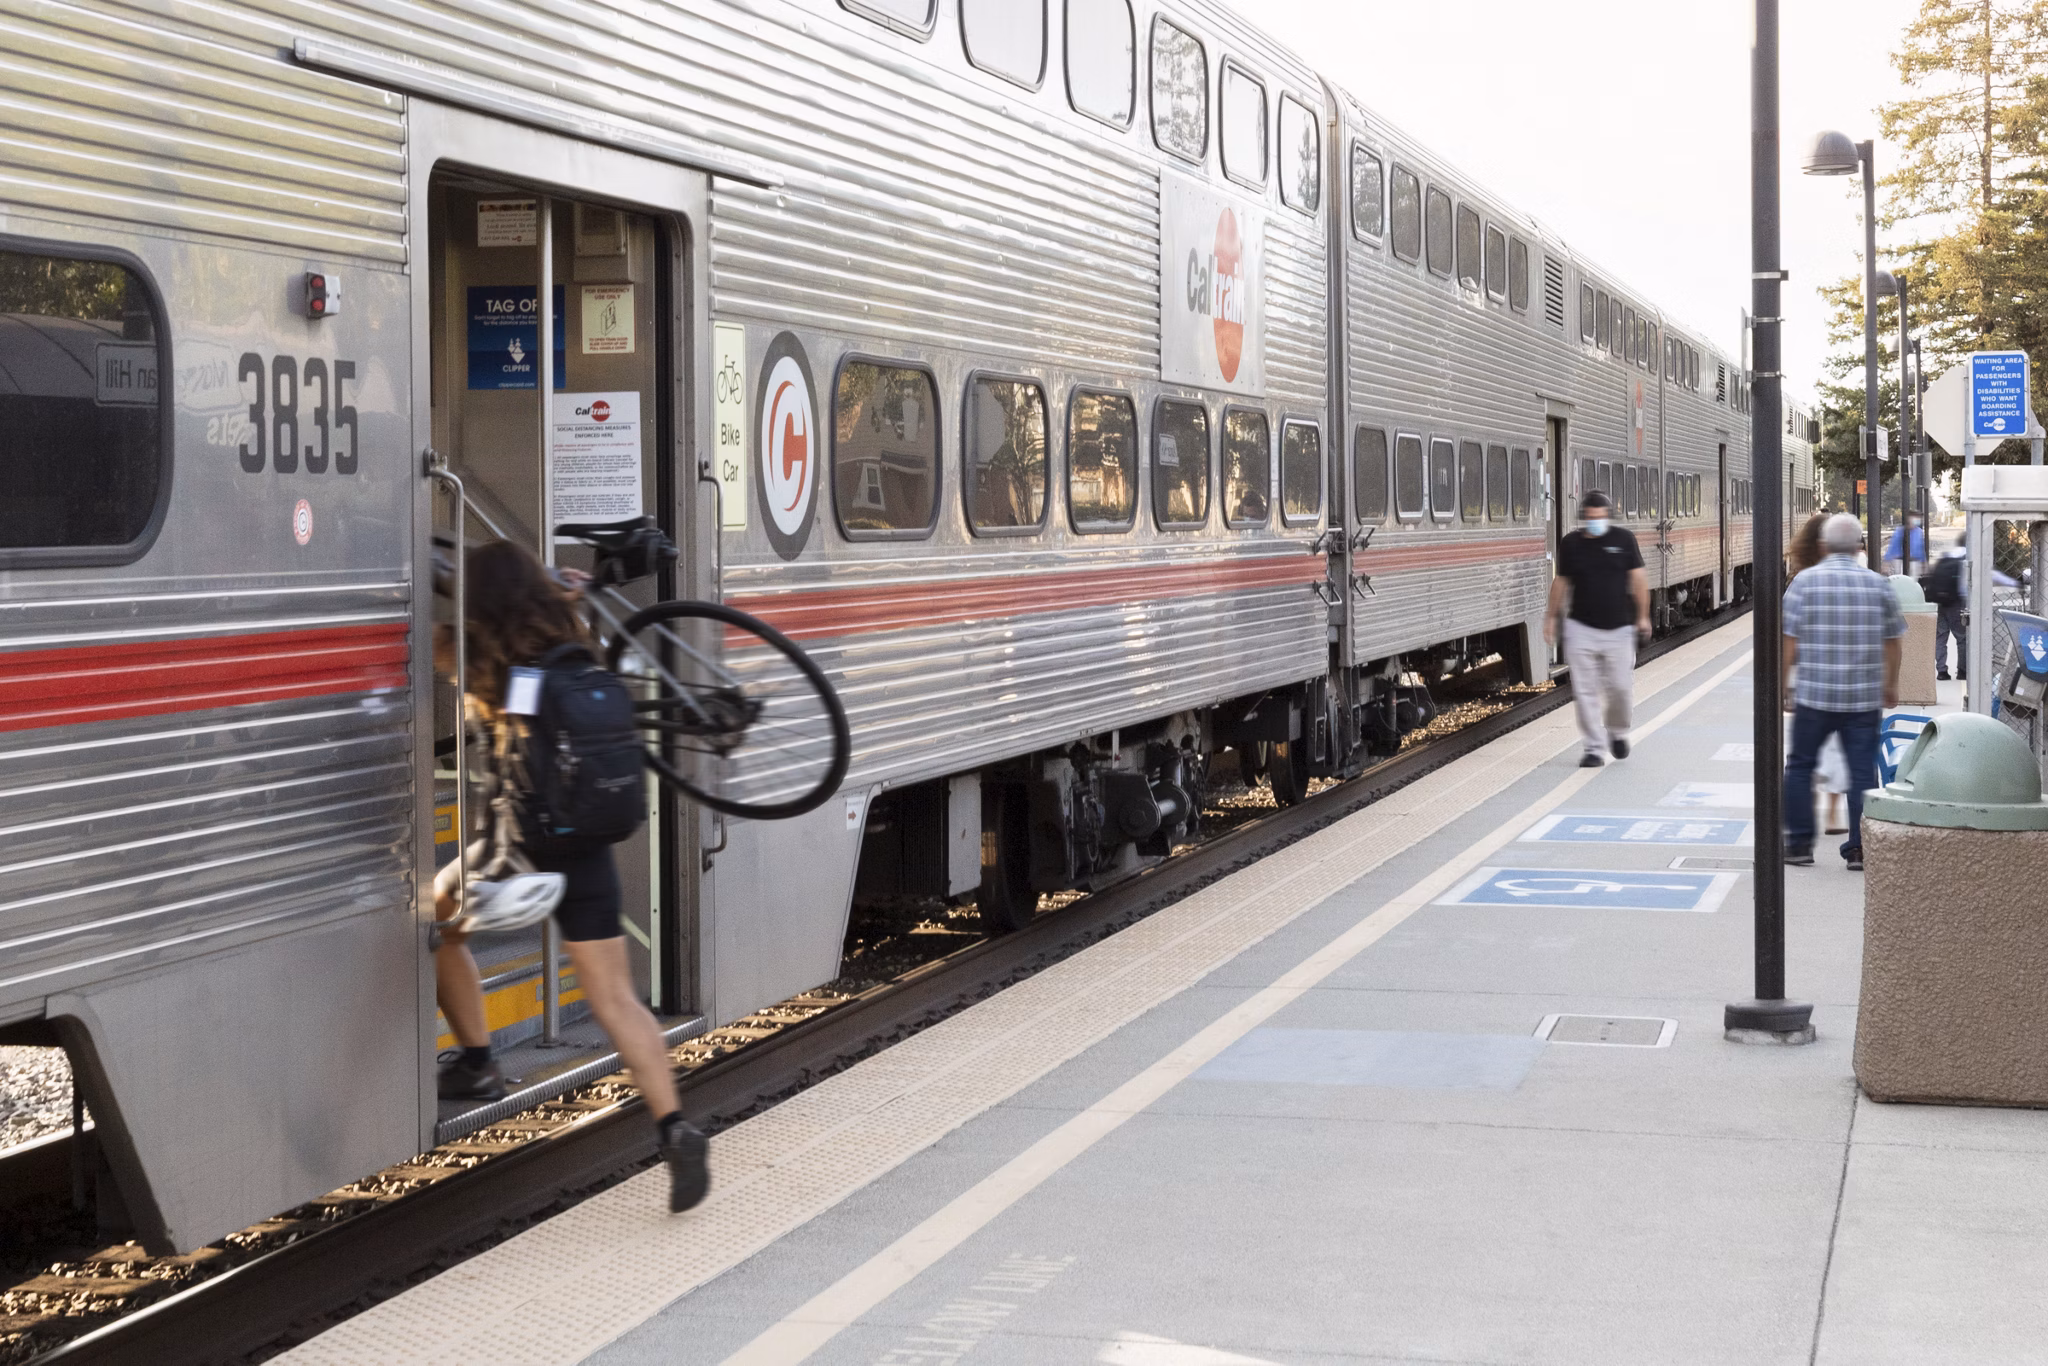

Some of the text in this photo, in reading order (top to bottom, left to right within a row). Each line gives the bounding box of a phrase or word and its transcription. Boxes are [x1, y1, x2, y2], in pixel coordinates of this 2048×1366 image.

[1187, 247, 1245, 325] Caltrain
[486, 299, 538, 312] TAG OF
[239, 353, 358, 474] 3835
[575, 404, 611, 416] Caltrain
[721, 423, 740, 446] Bike
[723, 459, 739, 482] Car
